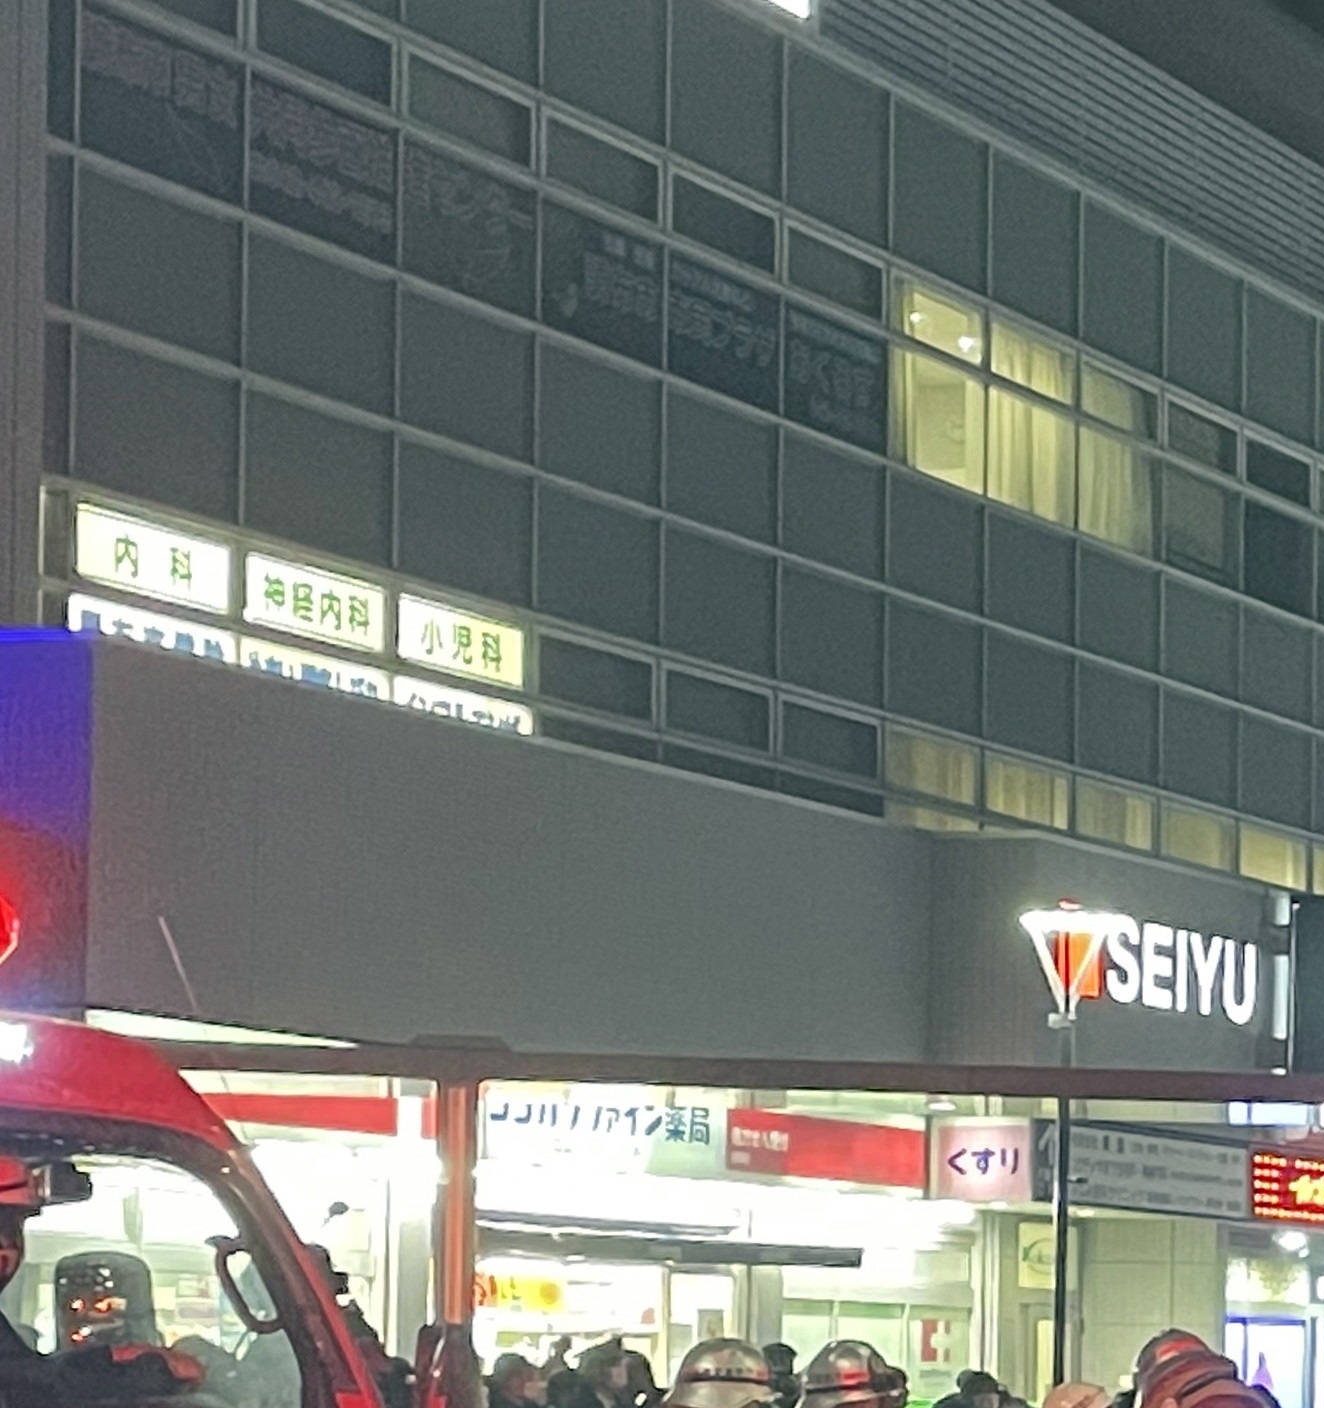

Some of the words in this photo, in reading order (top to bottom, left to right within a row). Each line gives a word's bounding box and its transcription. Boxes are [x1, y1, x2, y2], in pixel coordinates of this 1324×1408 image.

[115, 536, 192, 589] 内科
[419, 618, 503, 674] 小児科
[1104, 912, 1257, 1026] SEIYU
[947, 1147, 1020, 1175] くすり
